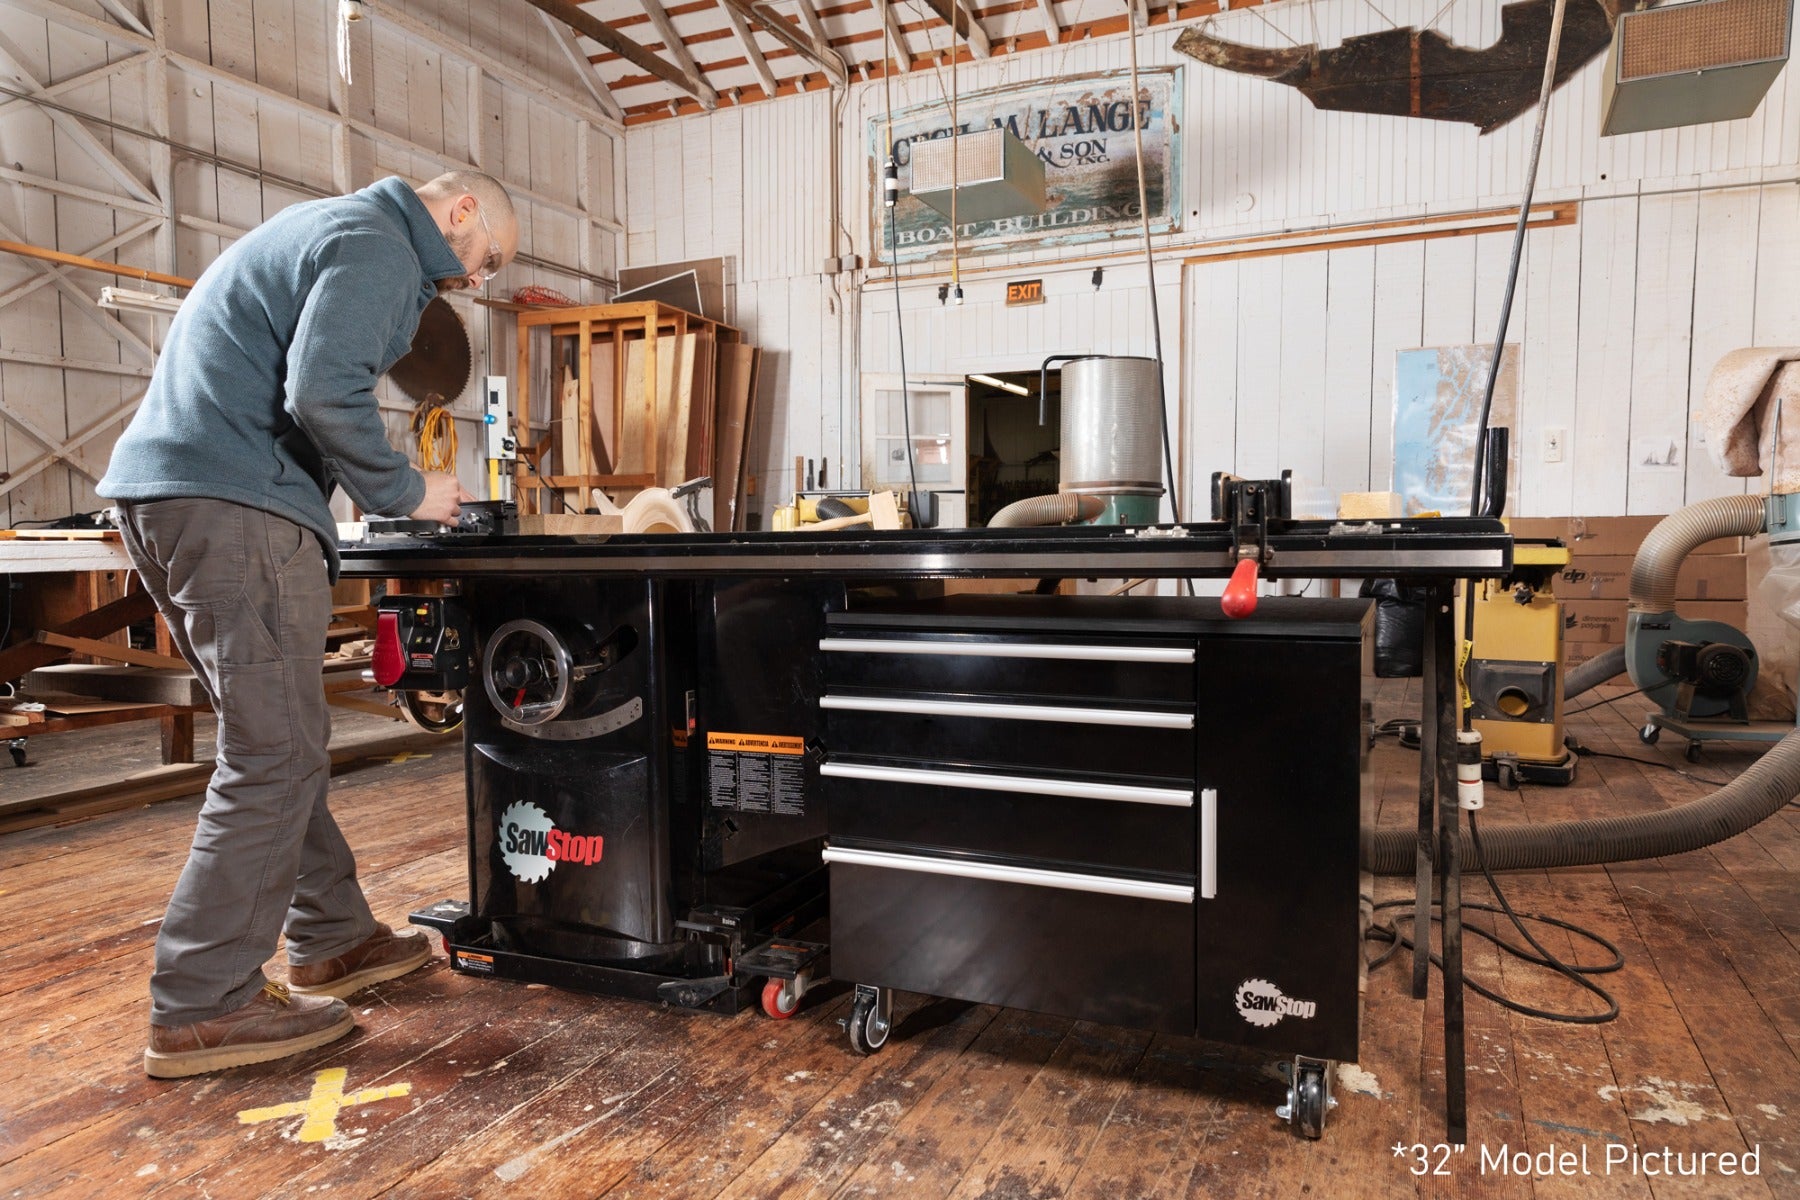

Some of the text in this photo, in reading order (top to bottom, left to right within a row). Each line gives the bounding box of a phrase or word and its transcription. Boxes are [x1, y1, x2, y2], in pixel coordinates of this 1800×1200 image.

[1038, 100, 1151, 139] LANGE
[1037, 138, 1107, 168] & SON
[1077, 155, 1110, 166] INC.
[992, 202, 1142, 233] BUILDING
[896, 222, 977, 245] BOAT
[1008, 283, 1041, 301] EXIT
[506, 822, 604, 866] SawStop
[1242, 990, 1317, 1019] SawStop
